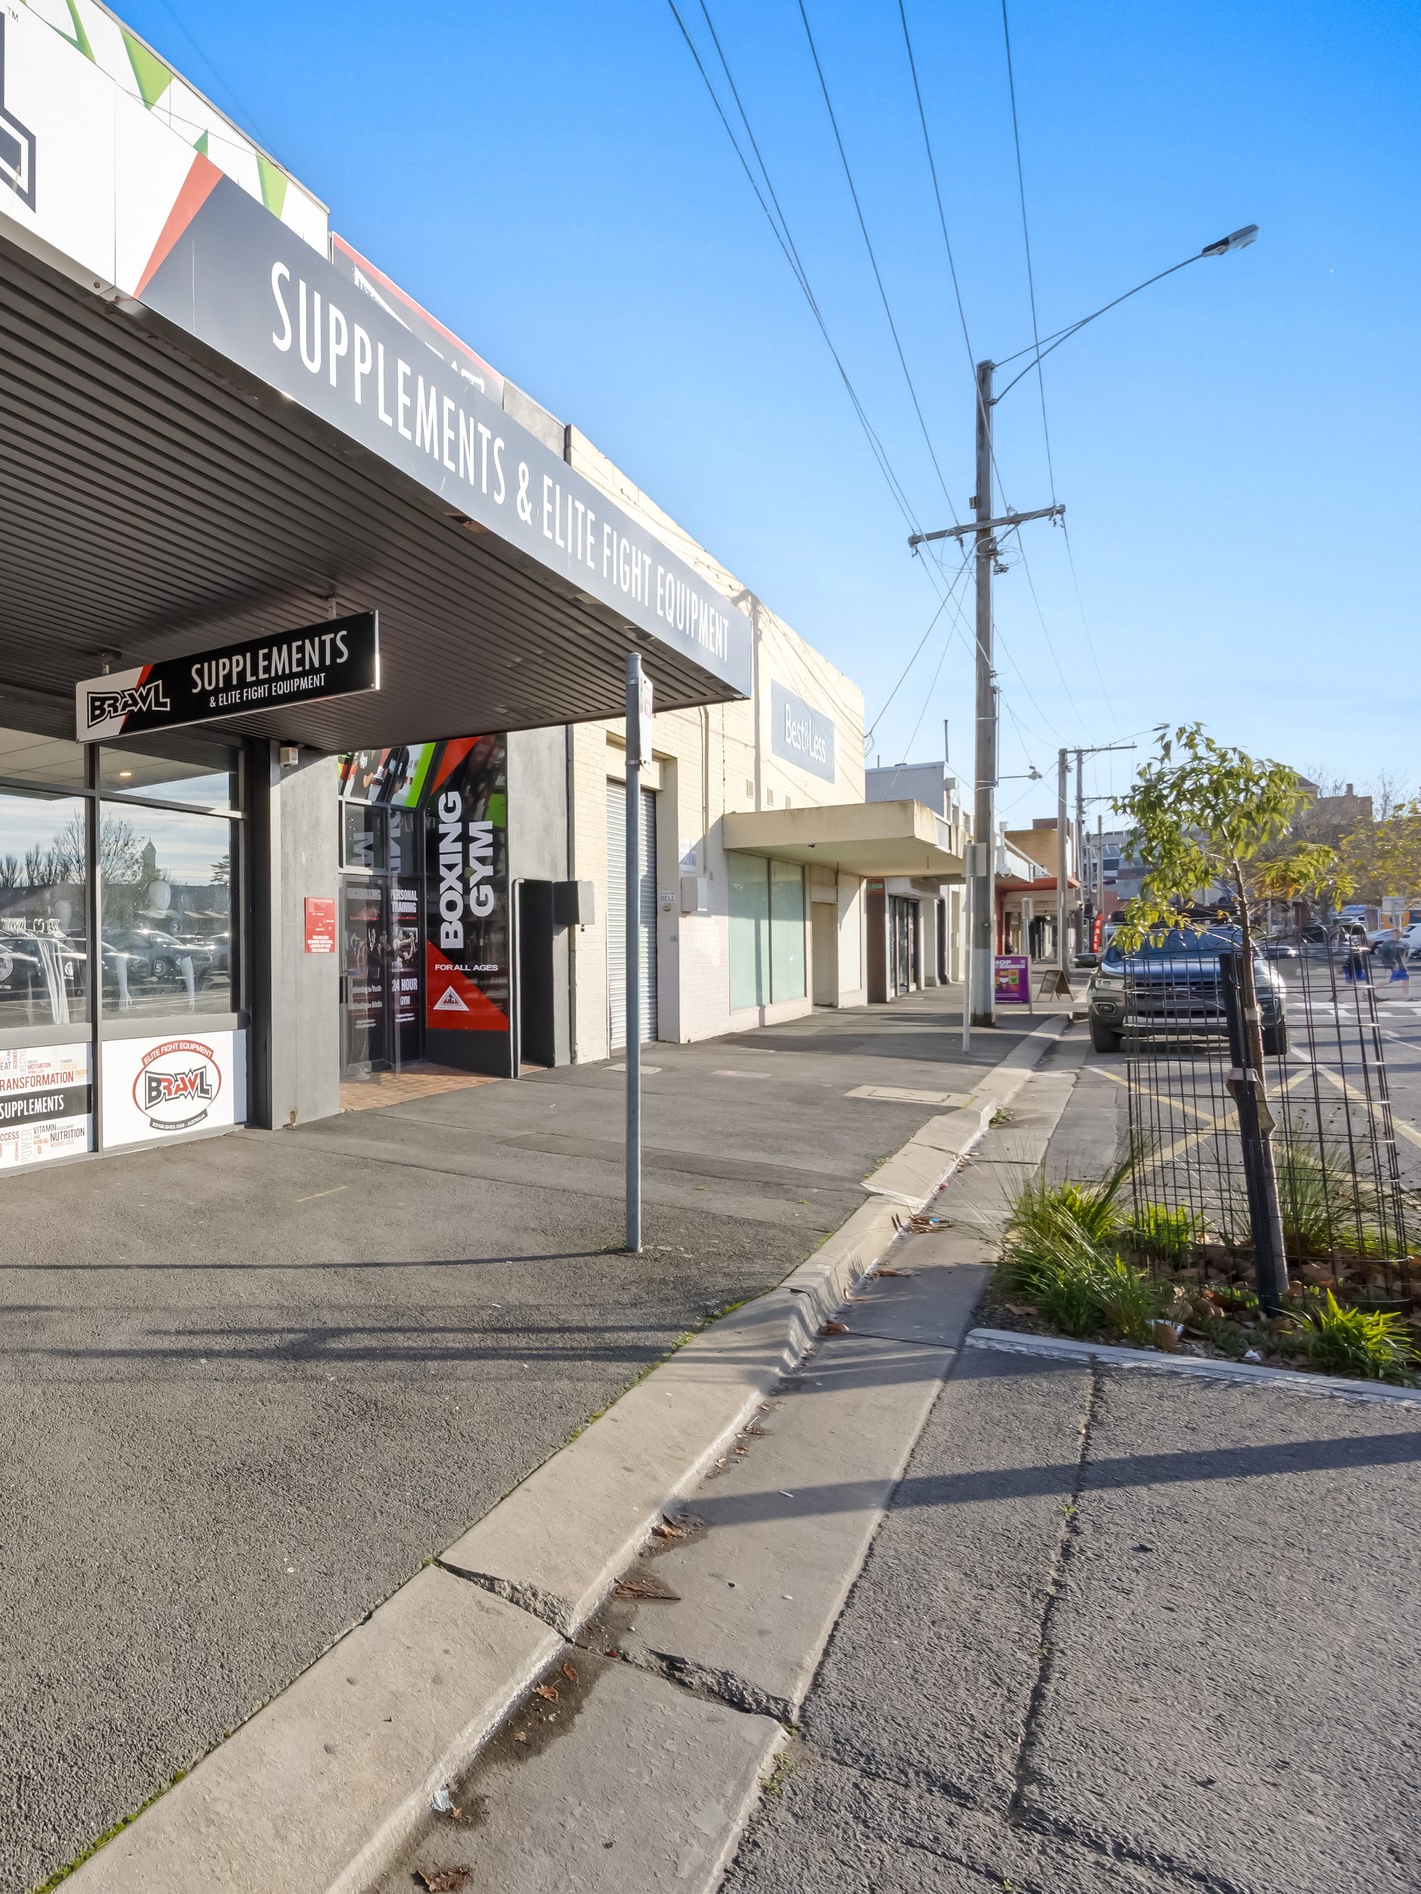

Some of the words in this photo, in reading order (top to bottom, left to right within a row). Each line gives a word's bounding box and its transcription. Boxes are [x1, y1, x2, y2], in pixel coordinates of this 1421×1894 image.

[271, 261, 505, 504] SUPPLEMENTS
[516, 461, 532, 526] &
[542, 474, 596, 569] ELITE
[602, 522, 651, 608] FIGHT
[656, 566, 729, 663] EQUIPMENT
[191, 630, 349, 694] SUPPLEMENTS
[87, 680, 170, 729] BRAWL
[209, 696, 217, 708] &
[218, 690, 241, 707] ELITE
[243, 686, 270, 702] FIGHT
[271, 673, 326, 696] EQUIPMENT
[438, 791, 464, 949] BOXING
[469, 820, 495, 917] GYM
[391, 889, 418, 901] PERSONAL
[155, 963, 162, 973] 5
[391, 980, 400, 991] 24
[401, 978, 418, 991] HOUR
[0, 1062, 12, 1071] EAT
[143, 1049, 161, 1064] ELITE
[160, 1042, 179, 1054] FIGHT
[180, 1042, 212, 1058] EQUIPMENT
[145, 1065, 212, 1110] BRAWL
[20, 1129, 33, 1163] POWER
[33, 1123, 57, 1135] VITAMIN
[50, 1127, 85, 1142] NUTRITION
